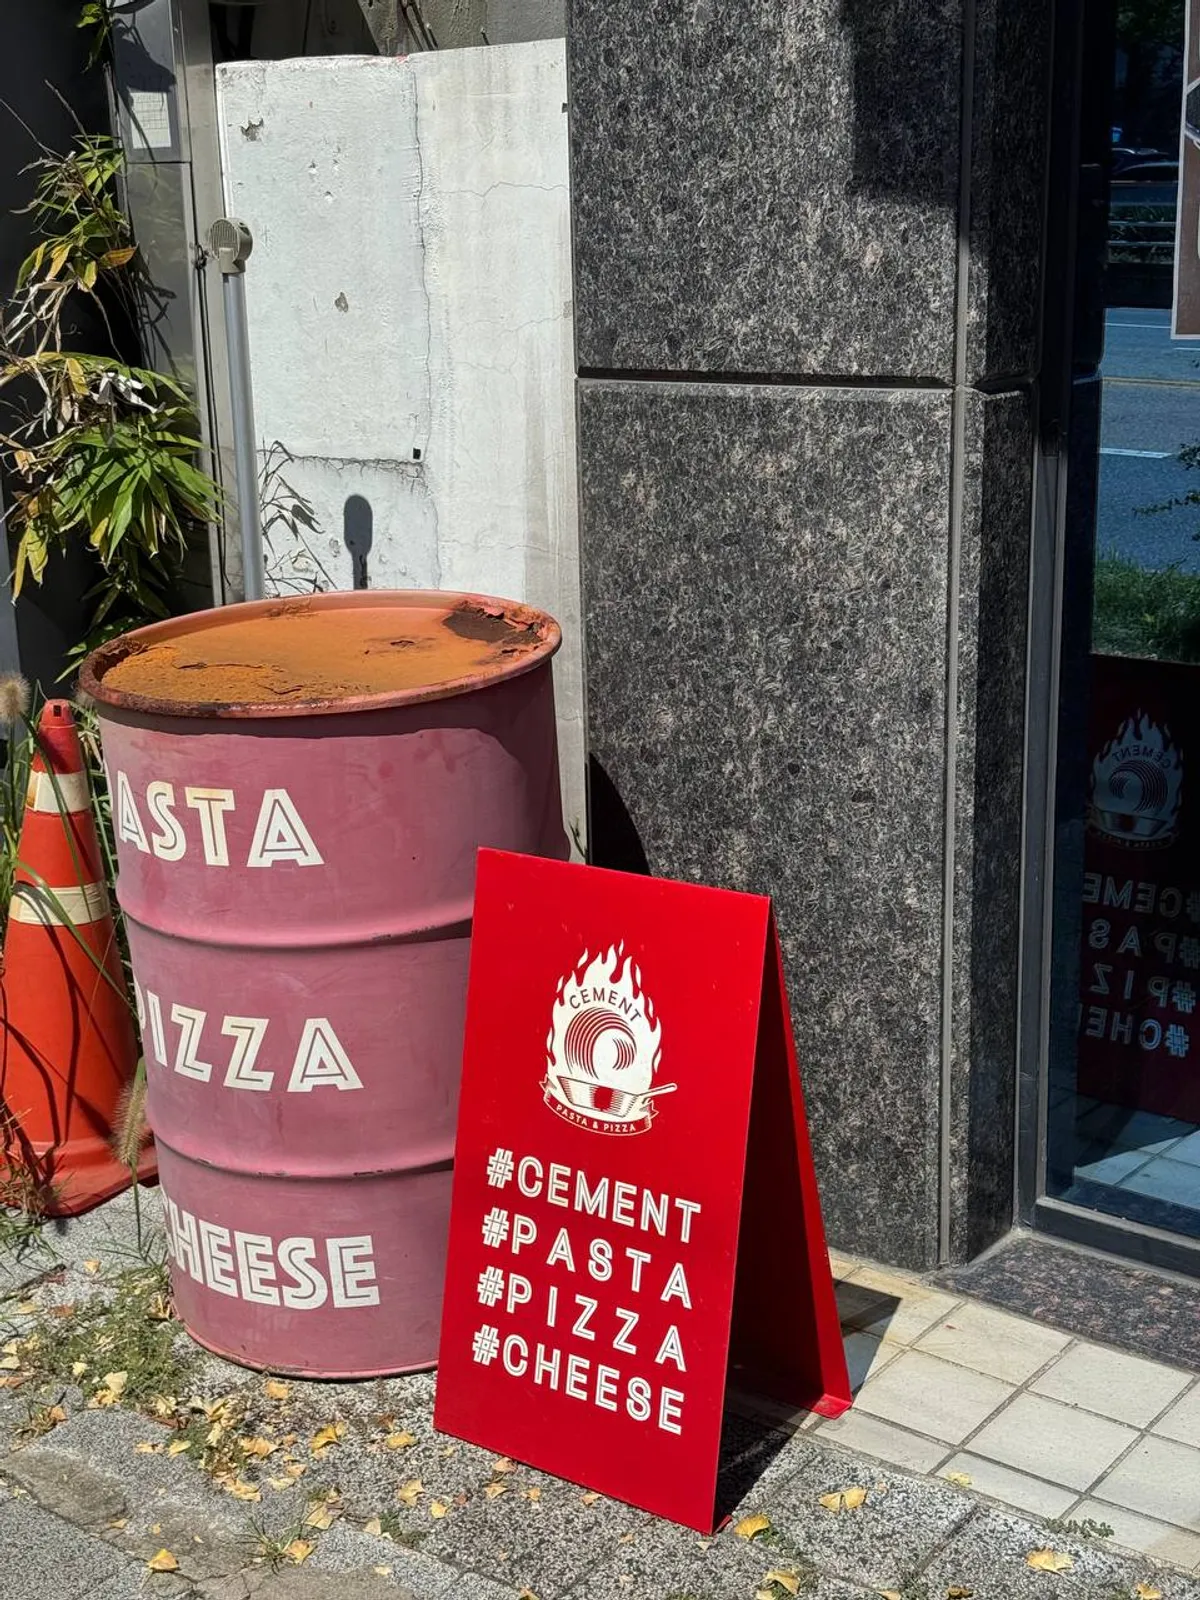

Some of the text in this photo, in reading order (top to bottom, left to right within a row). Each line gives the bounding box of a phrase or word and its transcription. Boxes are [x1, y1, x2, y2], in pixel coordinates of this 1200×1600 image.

[104, 758, 325, 868] ASTA
[569, 986, 643, 1023] CEMENT
[556, 1103, 637, 1134] PASTA & PIZZA
[486, 1147, 702, 1244] #CEMENT
[481, 1206, 693, 1310] #PASTA
[477, 1265, 688, 1373] #PIZZA
[472, 1323, 685, 1436] #CHEESE
